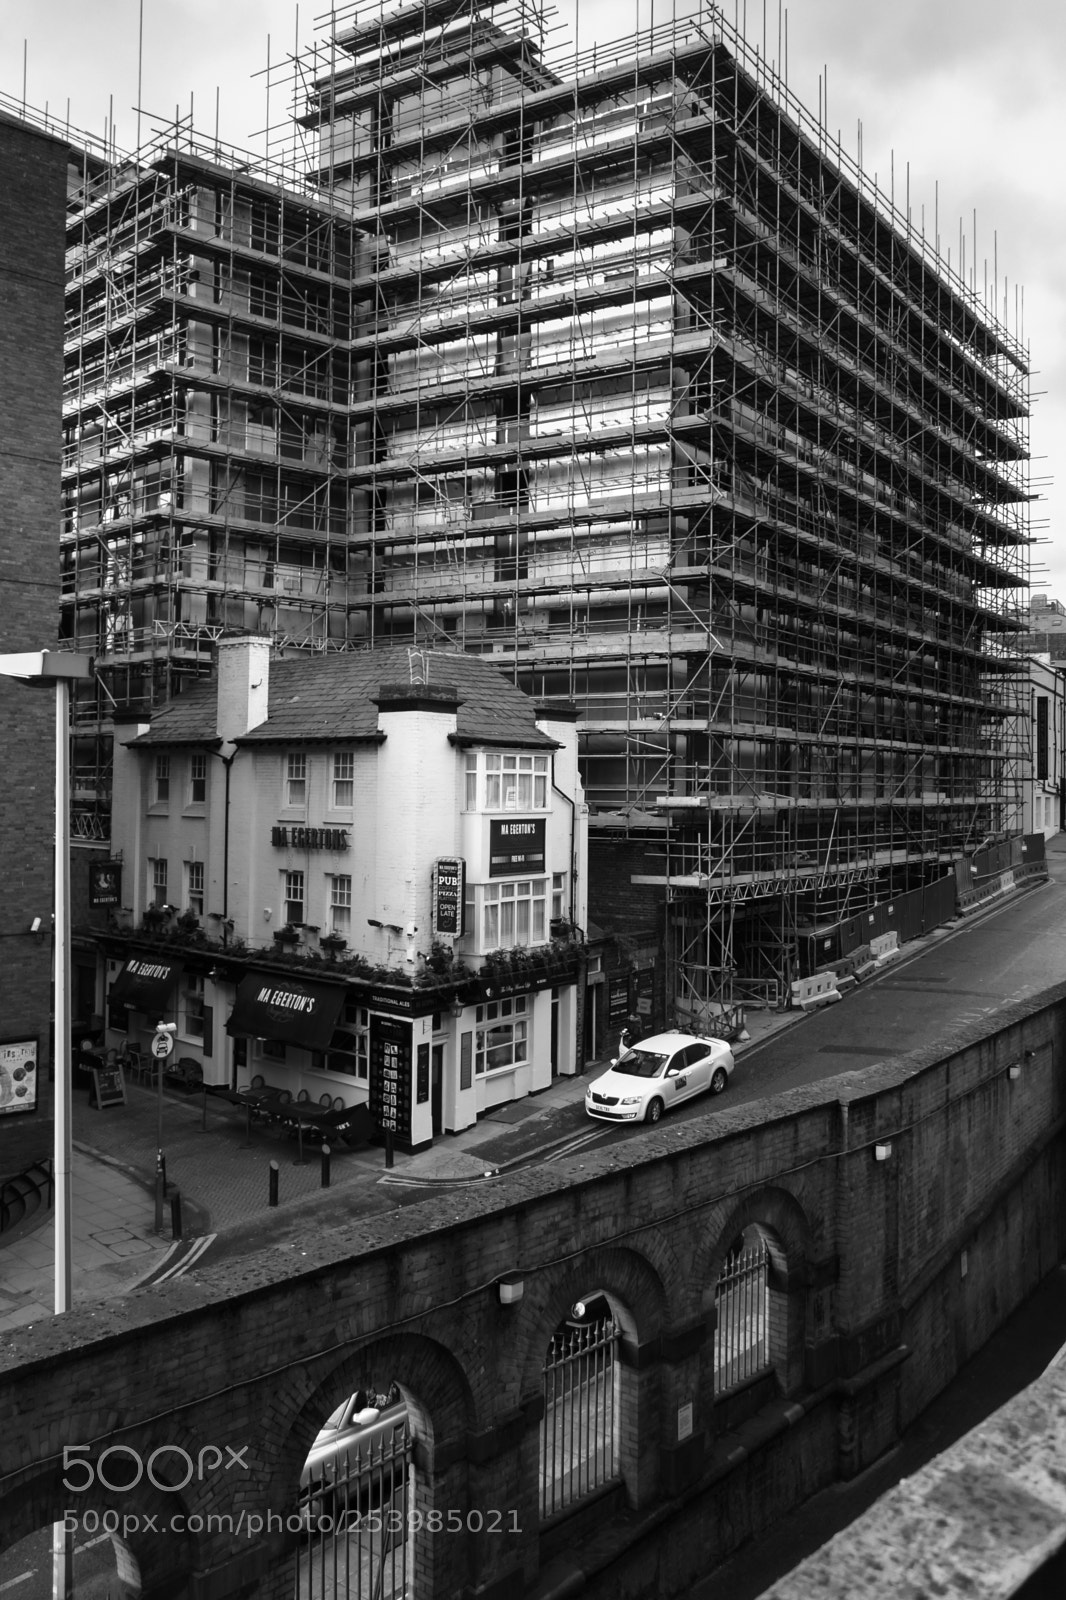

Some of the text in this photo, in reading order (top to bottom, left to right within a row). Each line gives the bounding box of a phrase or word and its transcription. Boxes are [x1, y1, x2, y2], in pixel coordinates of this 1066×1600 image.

[501, 824, 509, 835] MA
[272, 826, 288, 848] MA
[438, 876, 458, 886] PUB
[440, 903, 456, 911] OPEN
[440, 910, 455, 918] LATE
[126, 959, 140, 973] MA
[257, 987, 316, 1013] MA EGERTON'S
[372, 995, 398, 1006] TRADITIONAL
